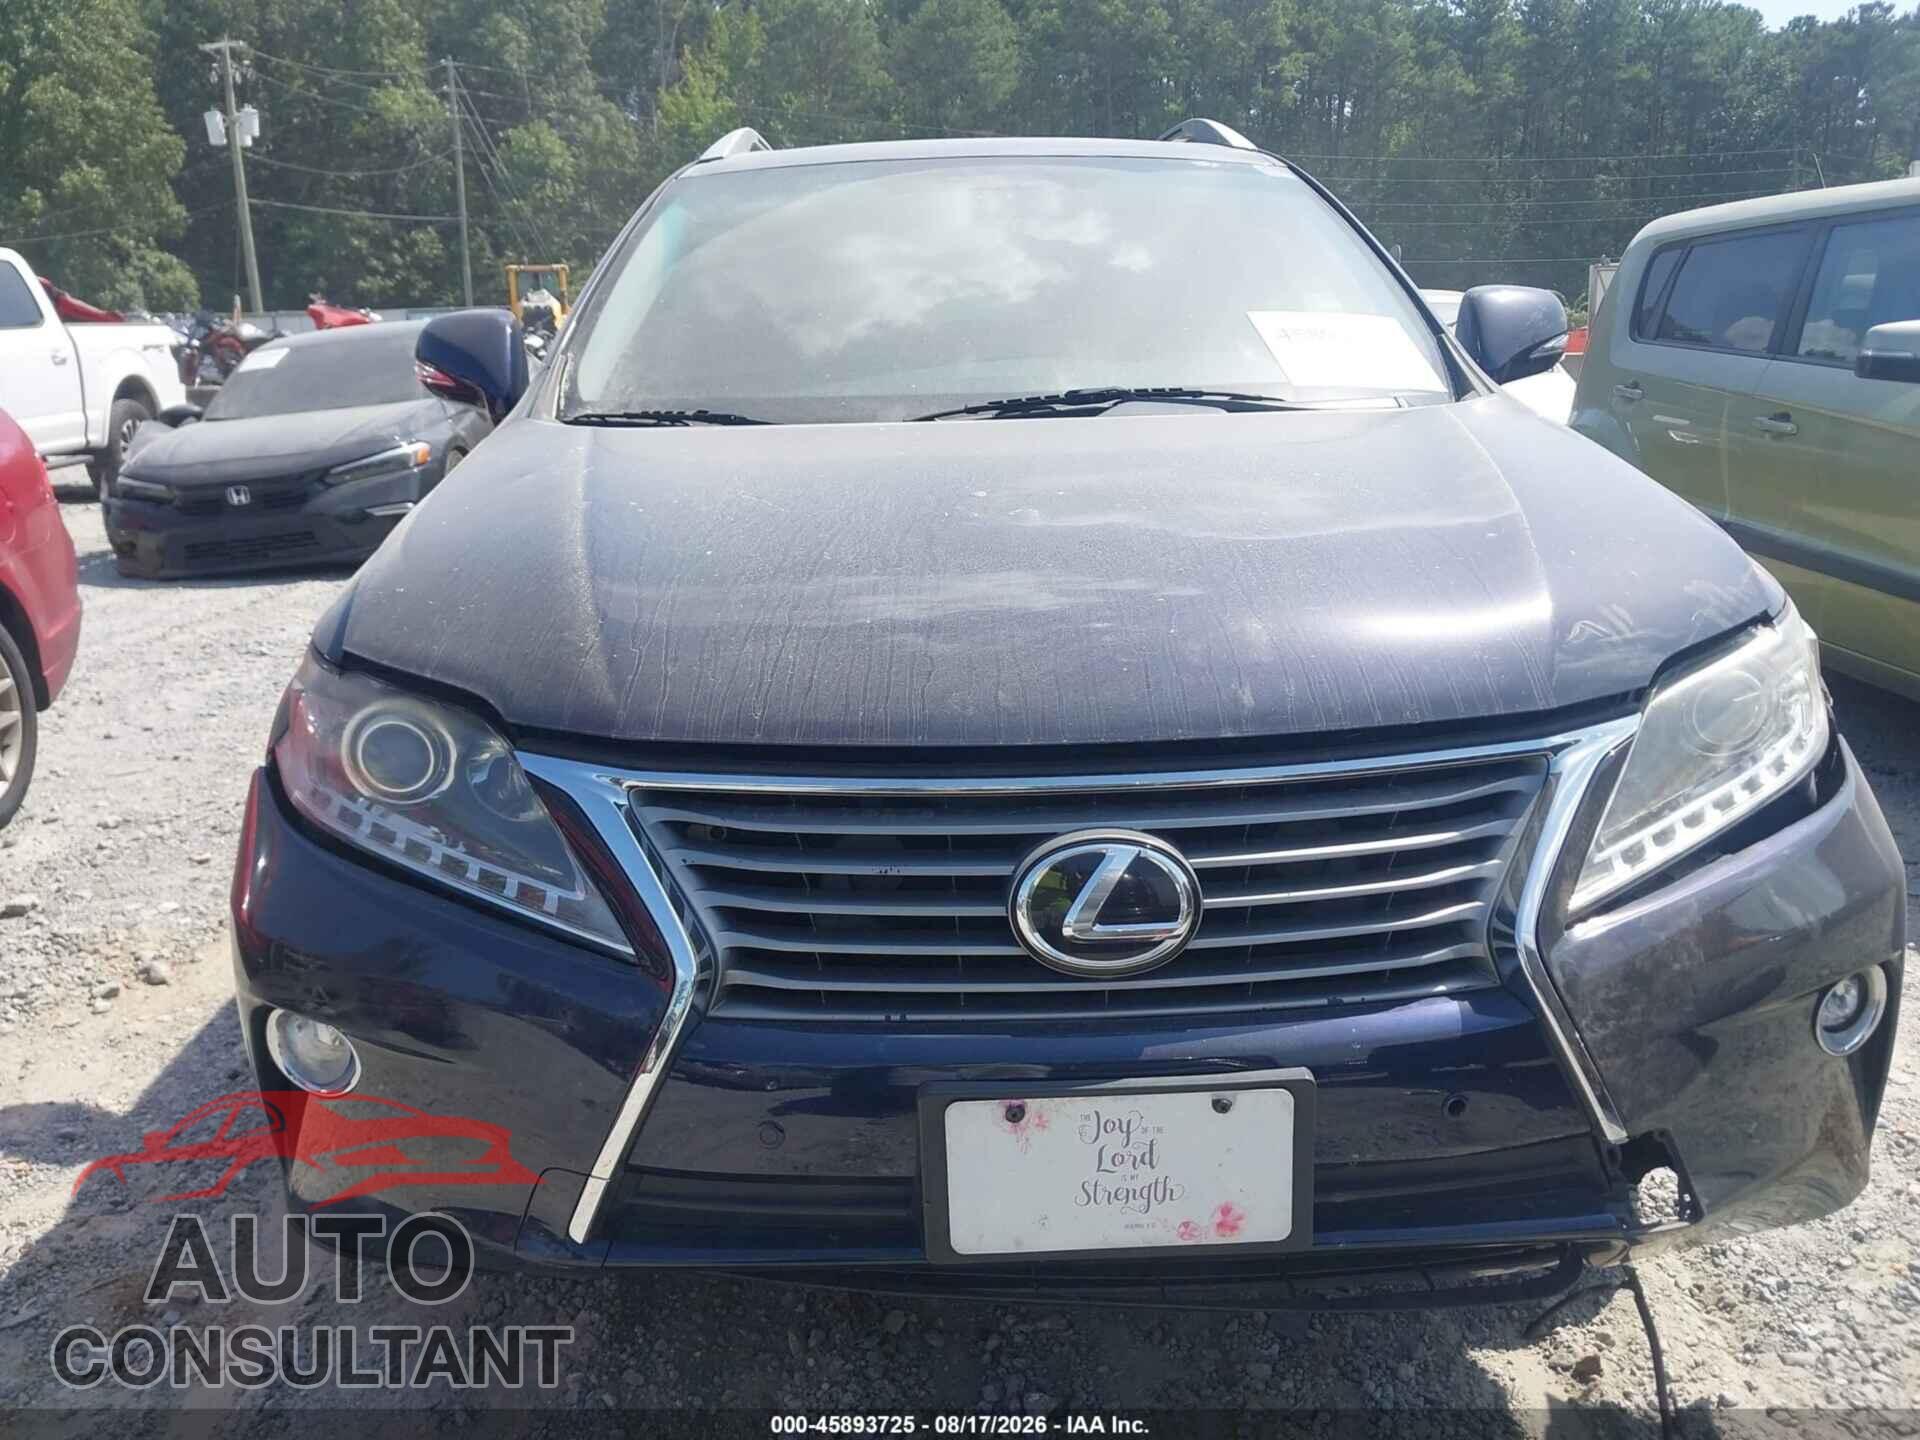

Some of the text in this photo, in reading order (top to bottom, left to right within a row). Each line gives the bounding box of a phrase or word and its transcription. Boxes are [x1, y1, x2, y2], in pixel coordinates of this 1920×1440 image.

[1078, 1110, 1144, 1148] Joy
[1096, 1138, 1160, 1173] Lord
[1074, 1176, 1185, 1214] Strength
